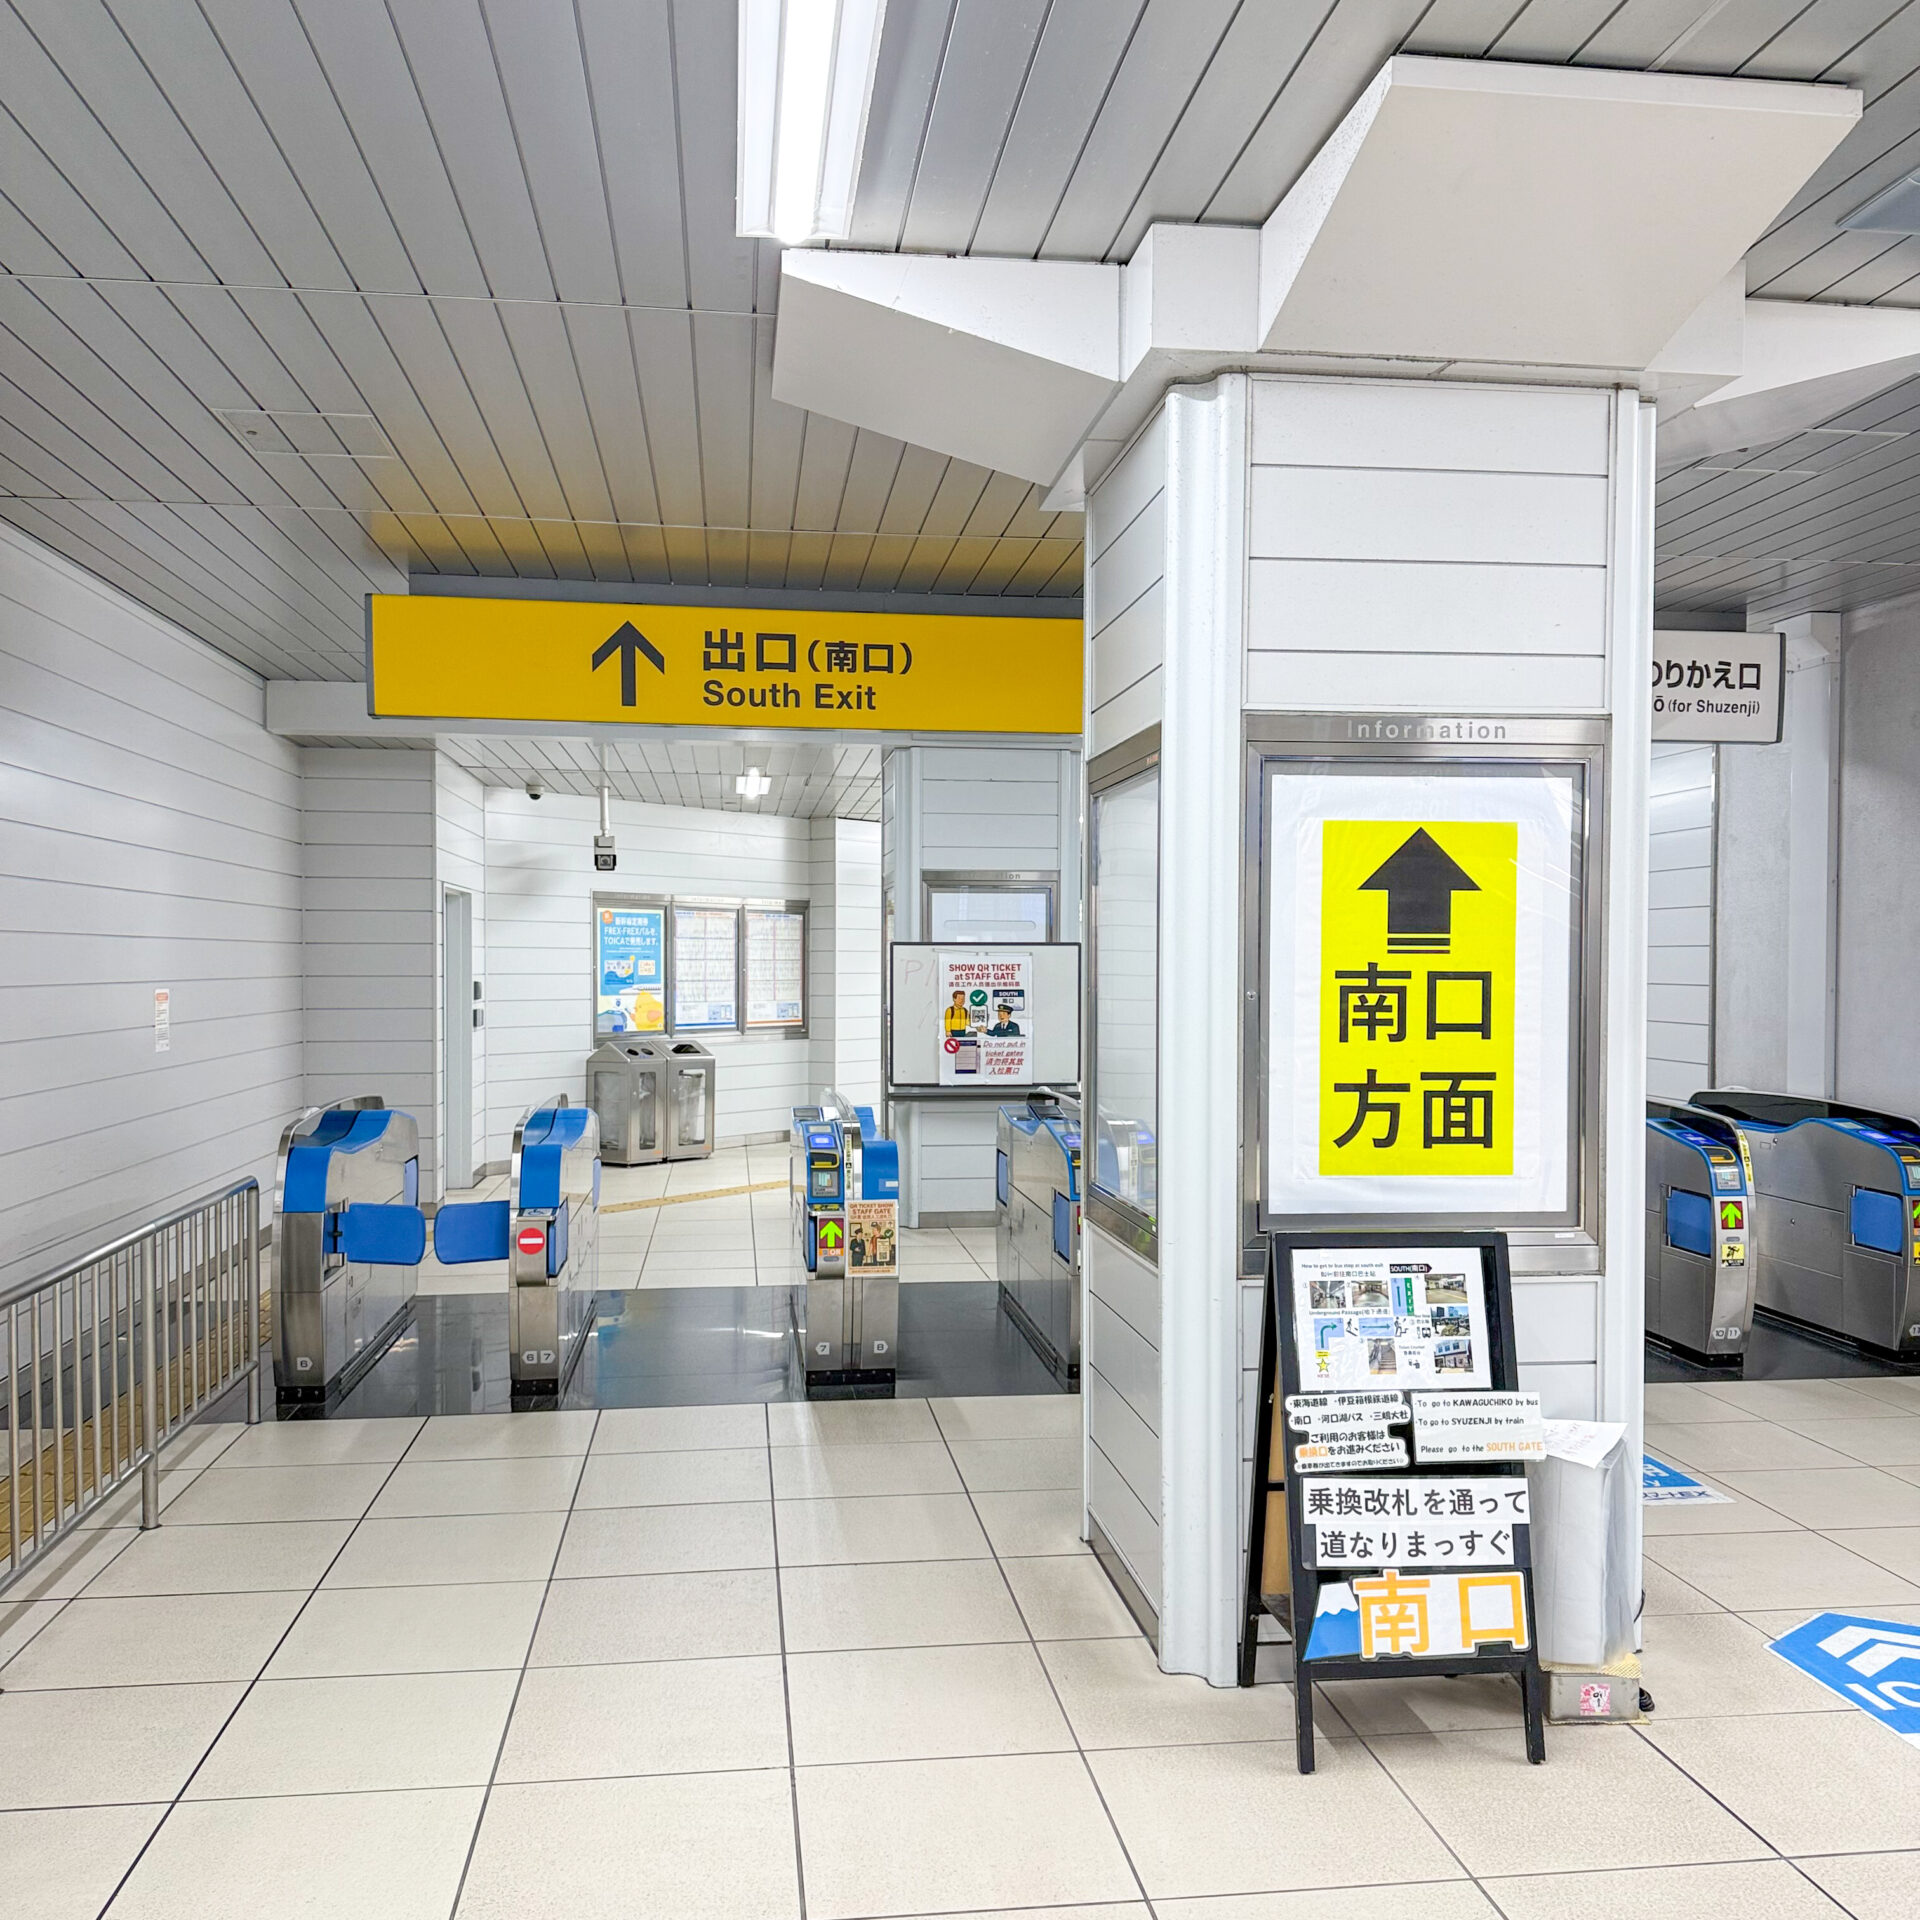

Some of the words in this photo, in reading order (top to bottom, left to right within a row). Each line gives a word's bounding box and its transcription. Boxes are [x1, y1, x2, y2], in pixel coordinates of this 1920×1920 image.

[703, 628, 913, 675] 出口(南口)
[703, 679, 801, 708] South
[815, 683, 876, 710] Exit
[1668, 699, 1692, 713] (for
[1696, 699, 1760, 717] Shuzenji)
[1347, 720, 1506, 739] Information
[948, 963, 976, 972] SHOW
[977, 963, 989, 972] QR
[991, 963, 1021, 972] TICKET
[964, 972, 991, 981] STAFF
[993, 972, 1016, 980] GATE
[1334, 961, 1492, 1043] 南口
[1333, 1069, 1497, 1149] 方面
[819, 1344, 827, 1352] 7
[300, 1359, 308, 1368] 6
[526, 1353, 535, 1362] 6
[543, 1353, 551, 1361] 7
[1417, 1400, 1427, 1408] To
[1443, 1399, 1451, 1407] to
[1452, 1398, 1513, 1407] KAWAGUCHIKO
[1515, 1398, 1524, 1406] by
[1526, 1398, 1538, 1406] bus
[1418, 1418, 1428, 1426] To
[1429, 1419, 1439, 1427] go
[1441, 1418, 1449, 1426] to
[1451, 1417, 1493, 1426] SYUZENJI
[1494, 1417, 1503, 1426] by
[1505, 1416, 1524, 1424] train
[1310, 1430, 1386, 1444] ご利用のお客様は
[1420, 1445, 1444, 1454] Please
[1448, 1446, 1457, 1454] go
[1461, 1444, 1471, 1453] to
[1472, 1443, 1484, 1452] the
[1486, 1441, 1516, 1452] SOUTH
[1518, 1441, 1543, 1451] GATE
[1308, 1487, 1527, 1516] 乗換改札を通って
[1320, 1529, 1510, 1558] 道なりまっすぐ
[1355, 1571, 1526, 1656] 南口
